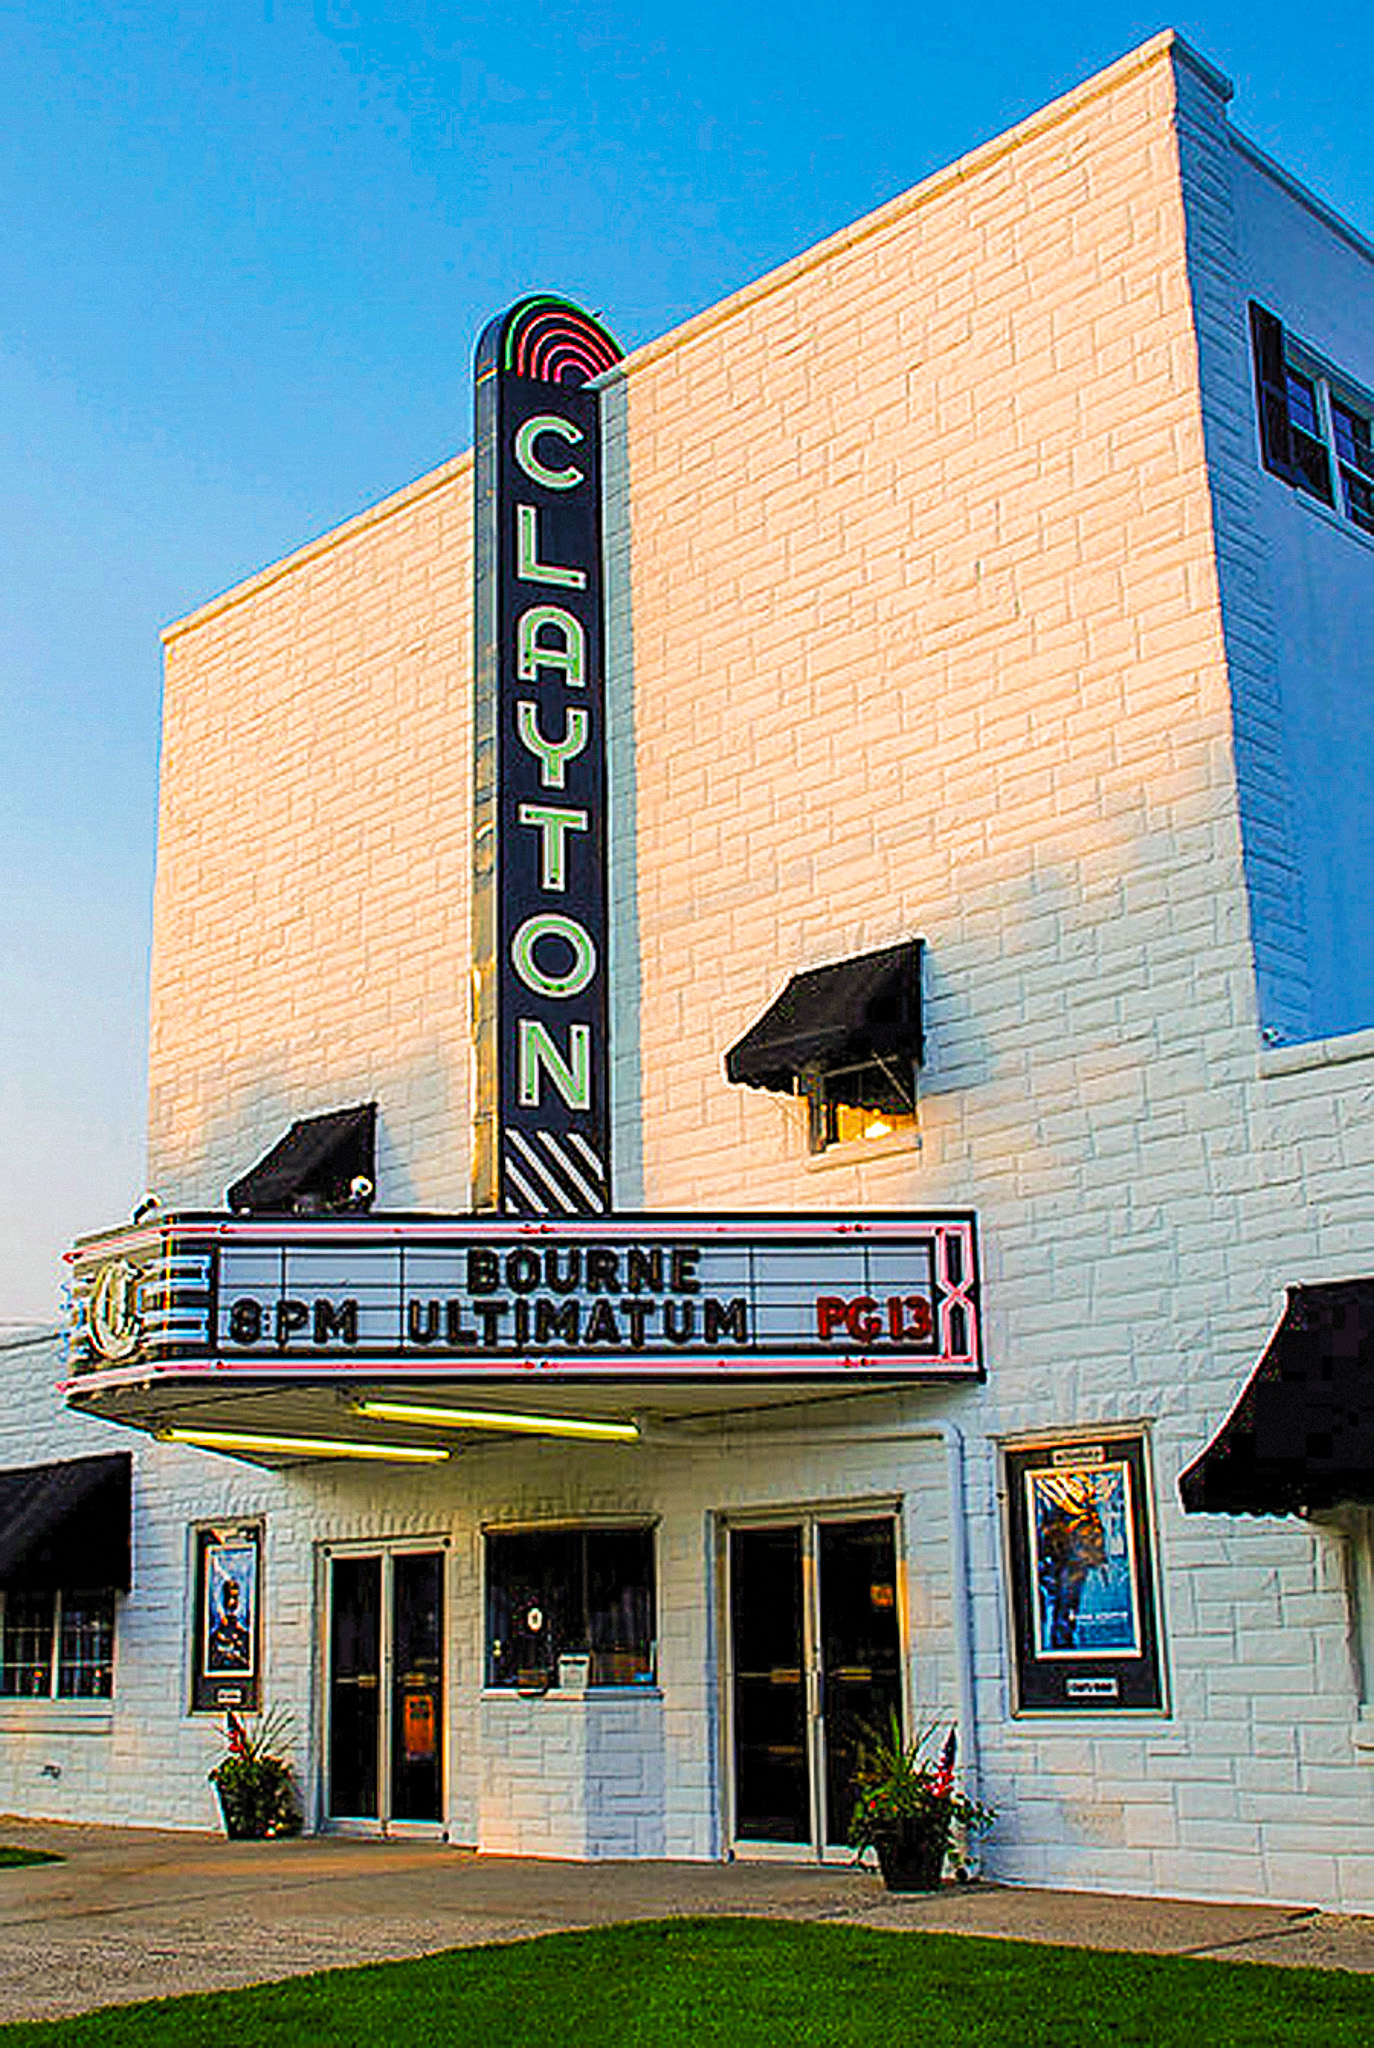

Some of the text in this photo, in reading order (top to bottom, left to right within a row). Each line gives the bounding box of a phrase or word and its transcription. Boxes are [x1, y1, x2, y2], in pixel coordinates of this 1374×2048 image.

[511, 415, 597, 1111] CLAYTON
[467, 1248, 700, 1294] BOURNE
[230, 1298, 358, 1344] 8:PM
[408, 1299, 748, 1347] ULTIMATUM
